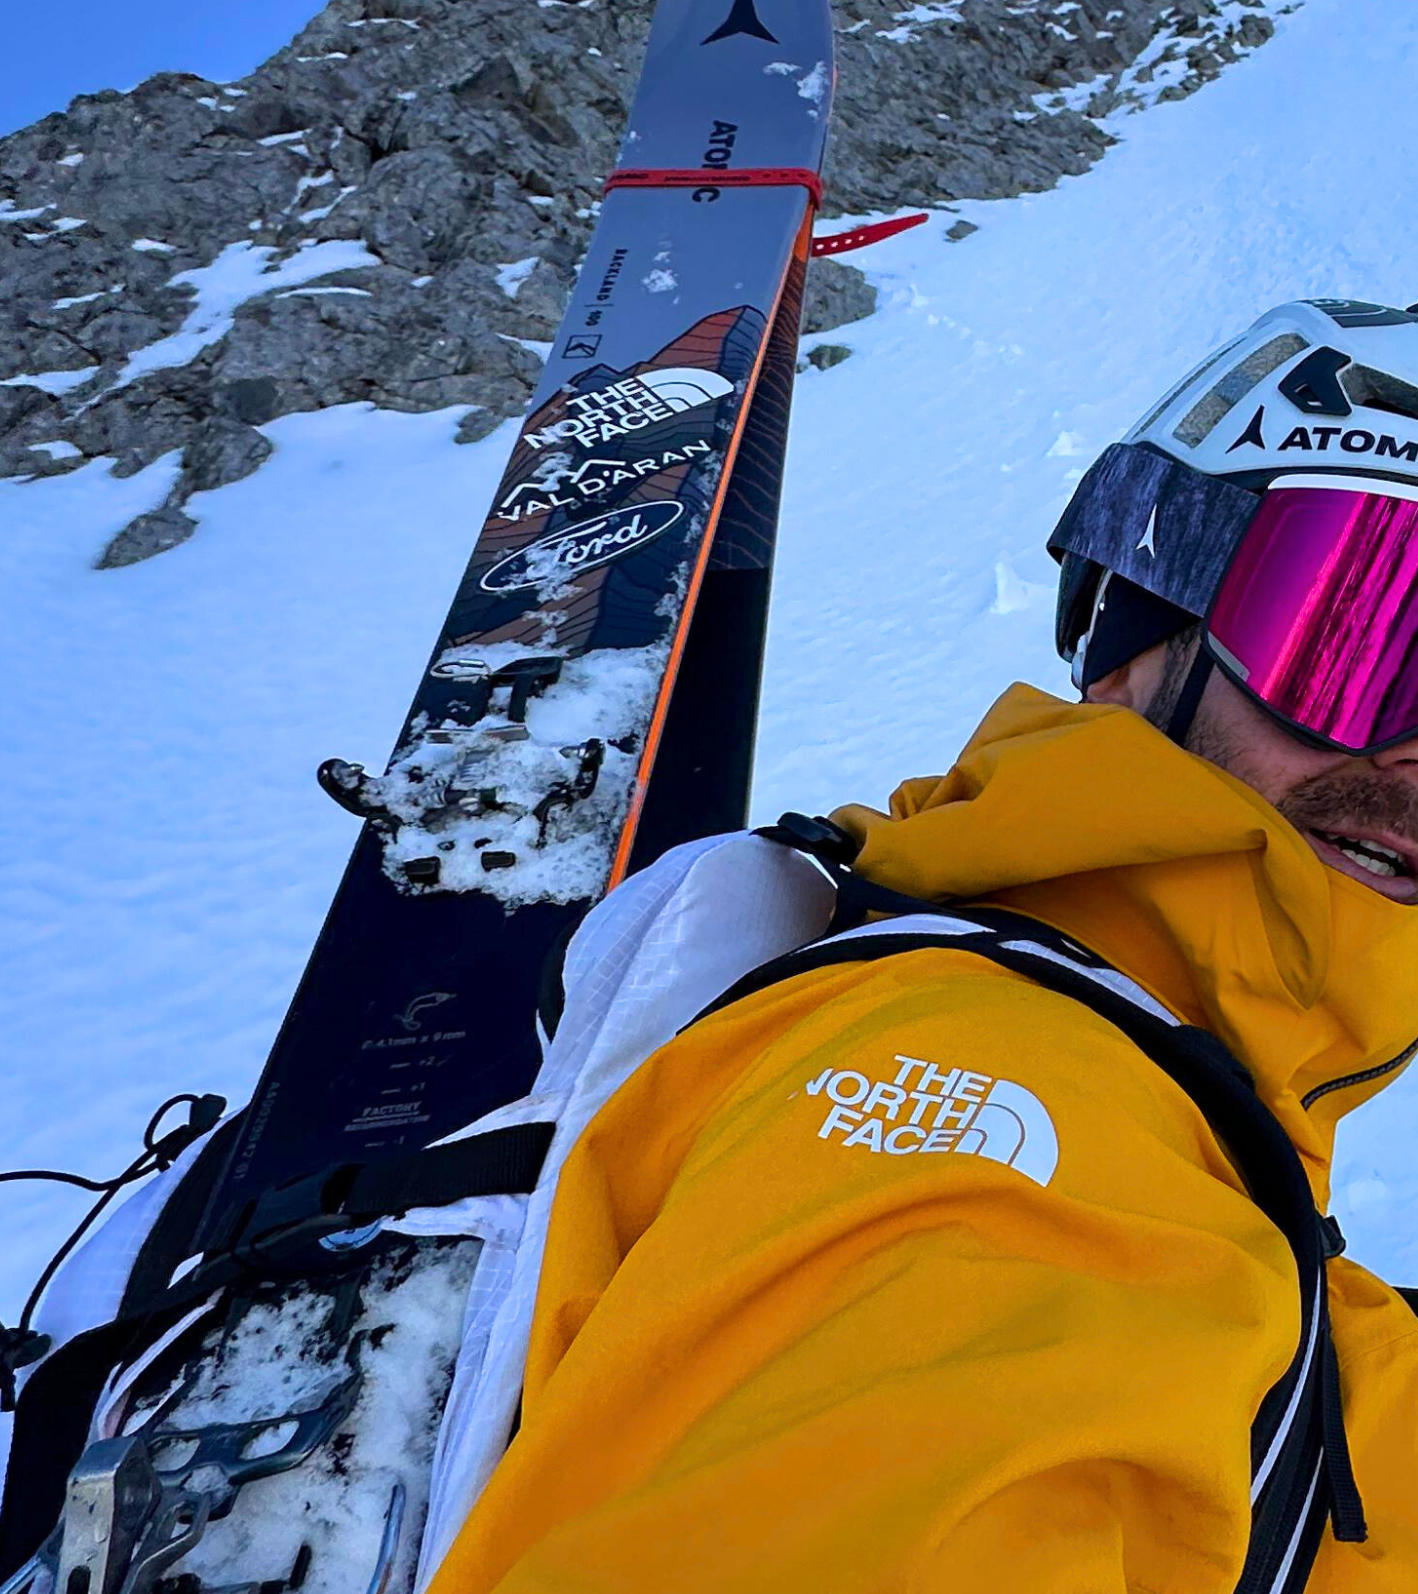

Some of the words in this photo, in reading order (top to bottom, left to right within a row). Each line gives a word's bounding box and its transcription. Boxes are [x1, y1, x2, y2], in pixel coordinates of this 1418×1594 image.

[692, 120, 738, 202] ATOC
[597, 249, 628, 301] BACKLAND
[523, 387, 658, 449] NORTH
[566, 377, 642, 412] THE
[575, 403, 674, 449] FACE
[497, 493, 575, 521] VAL
[526, 513, 649, 577] Ford
[894, 1054, 993, 1104] THE
[817, 1104, 963, 1155] FACE
